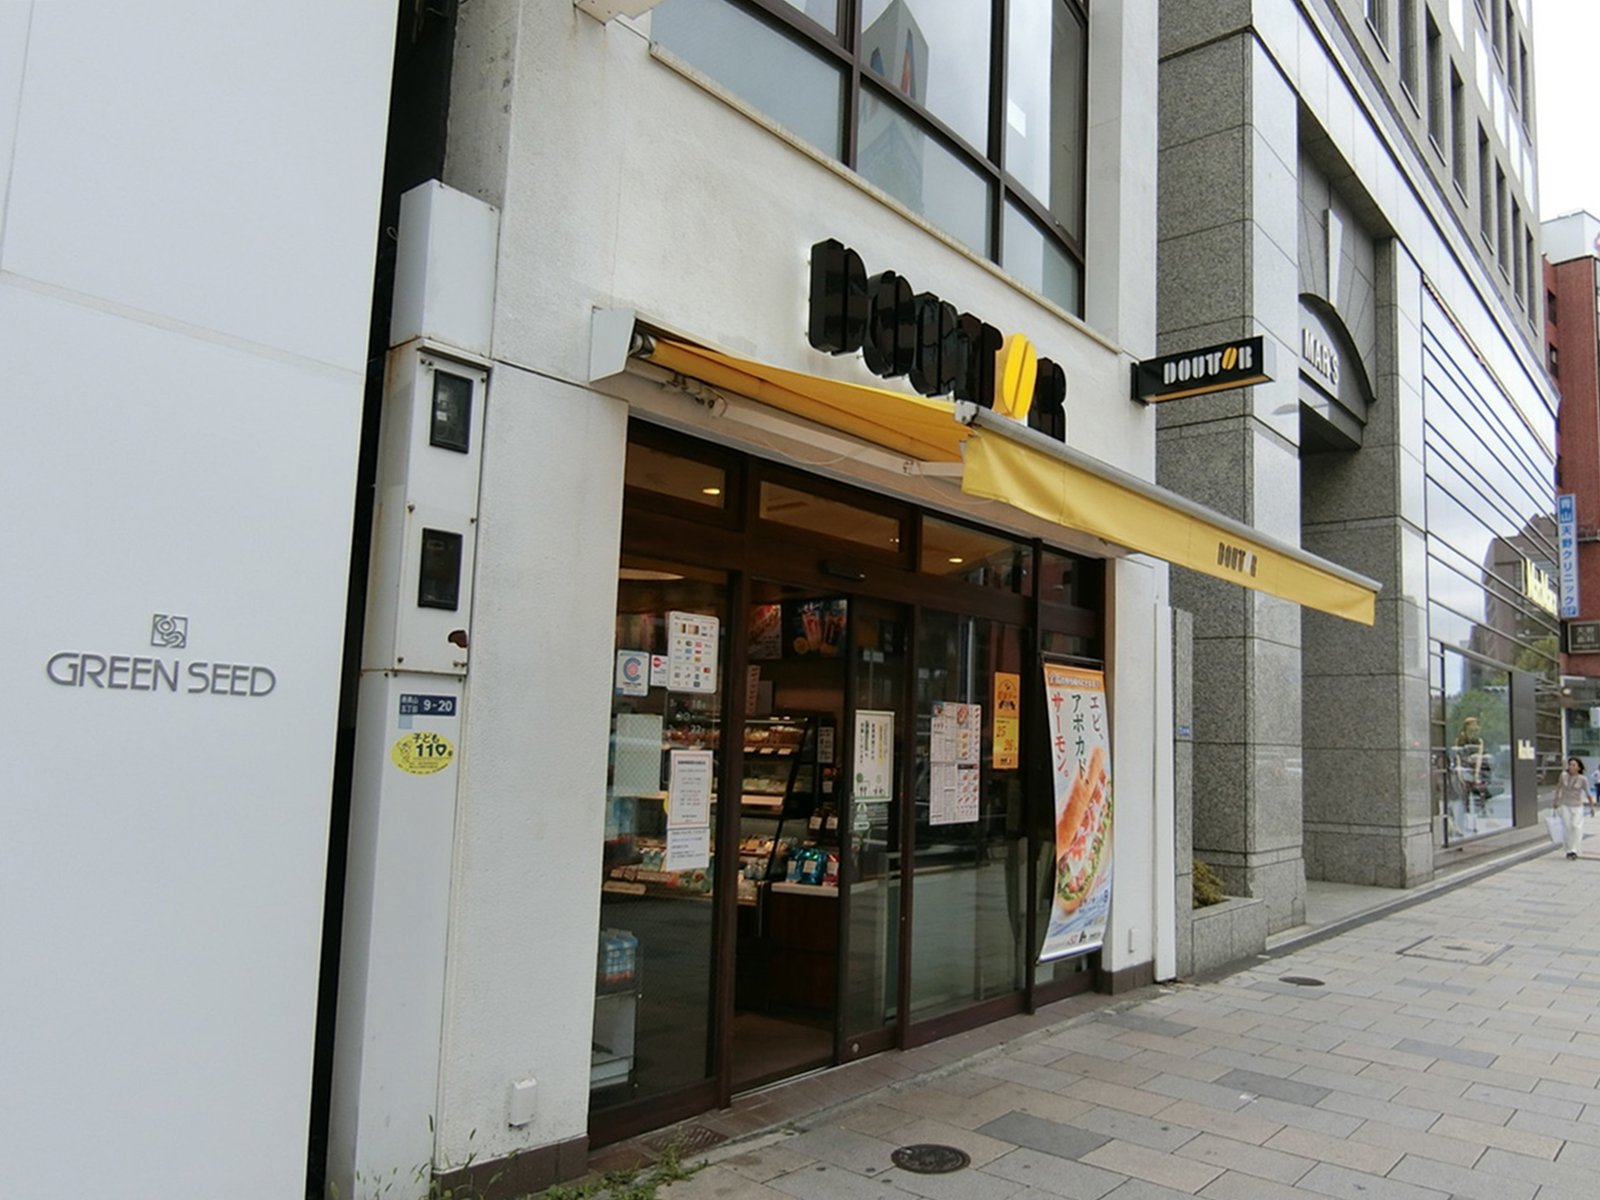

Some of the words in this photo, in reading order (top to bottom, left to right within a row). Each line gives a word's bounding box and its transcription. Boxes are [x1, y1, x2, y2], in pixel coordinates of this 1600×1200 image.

[1163, 346, 1253, 385] DOUTOR
[1302, 327, 1339, 386] MAR'S
[46, 652, 180, 693] GREEN
[187, 662, 276, 697] SEED
[423, 699, 453, 712] 9-20
[412, 733, 440, 744] 子ども
